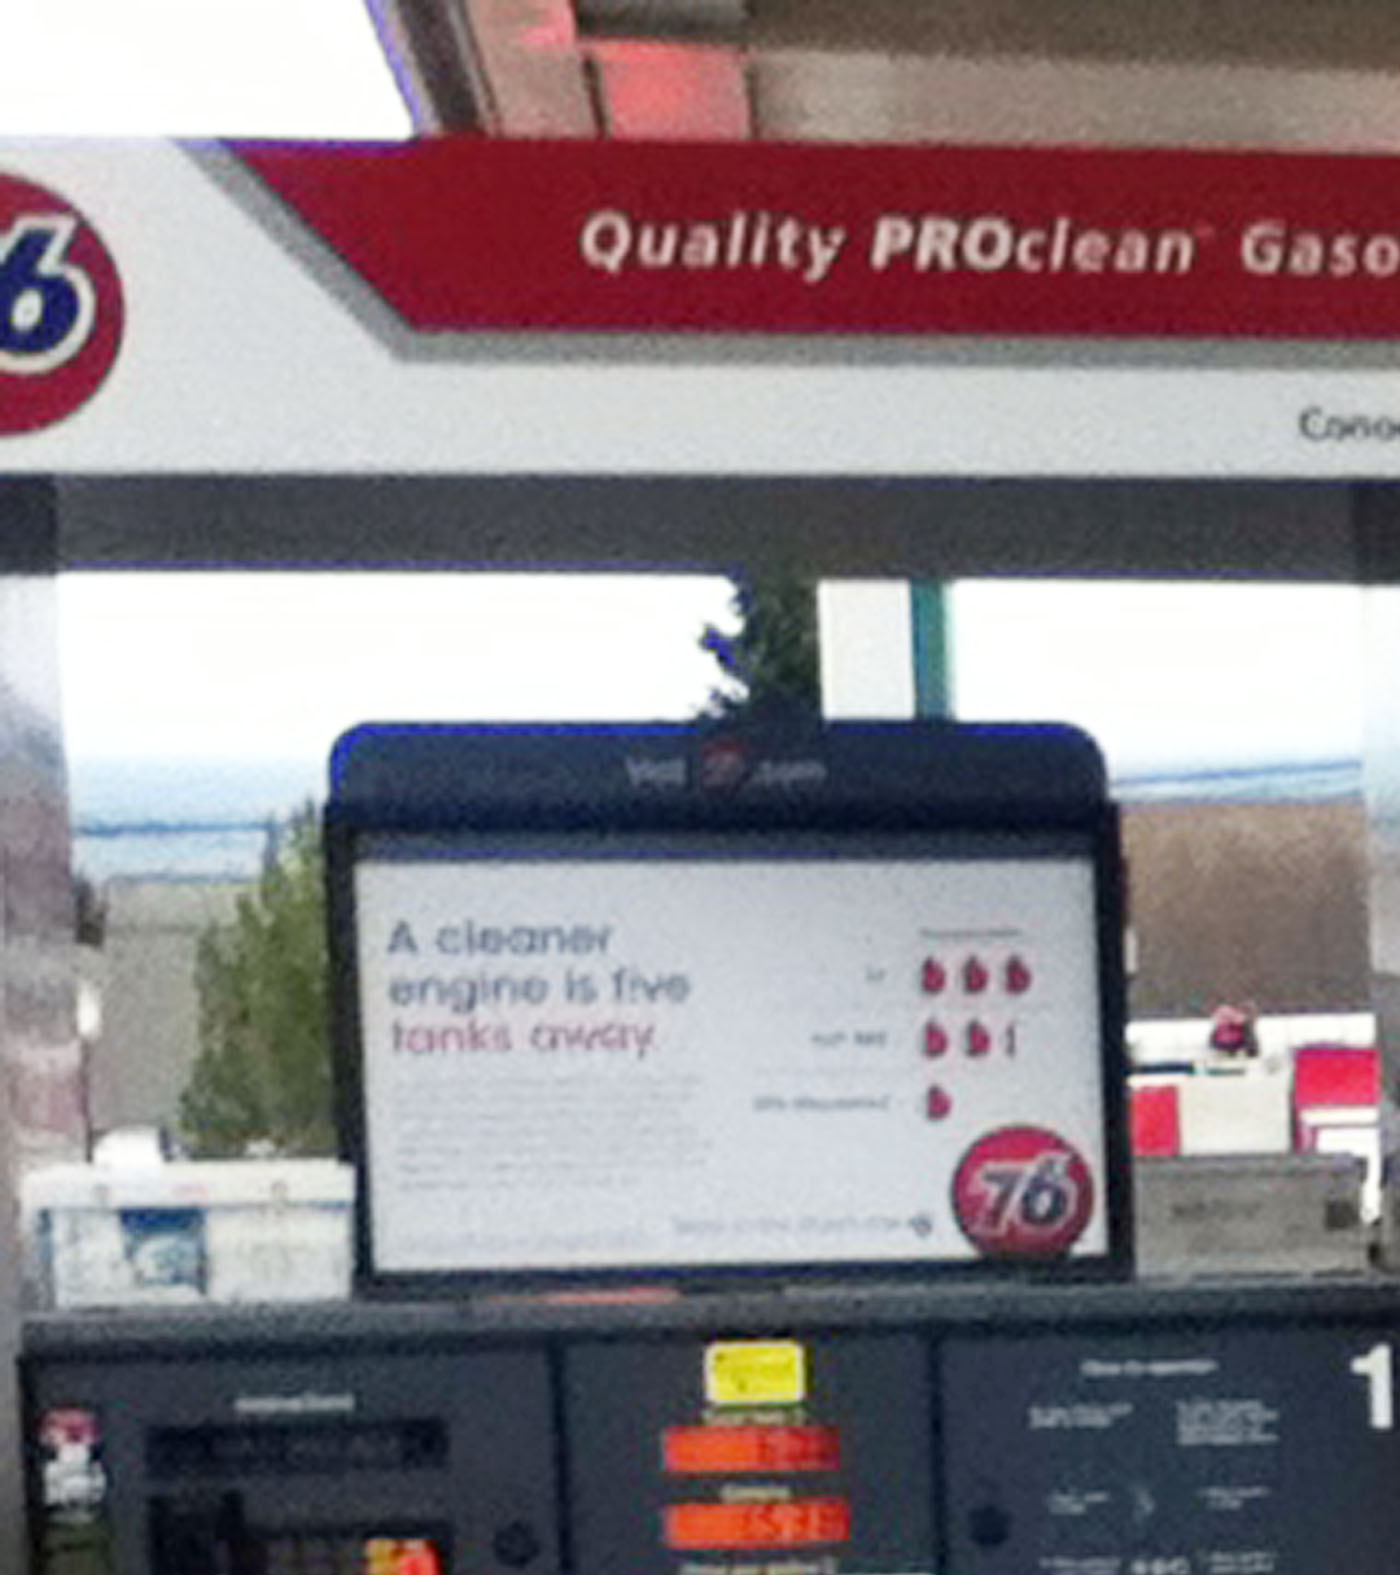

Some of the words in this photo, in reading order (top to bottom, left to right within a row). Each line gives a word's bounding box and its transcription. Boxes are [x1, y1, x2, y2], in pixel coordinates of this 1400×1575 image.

[580, 208, 848, 283] Quality
[869, 214, 1197, 275] PROclean
[0, 213, 95, 374] 6
[387, 917, 419, 952] A
[434, 918, 614, 956] cleaner
[388, 972, 551, 1014] engine
[566, 970, 600, 1005] is
[611, 966, 692, 1006] five
[391, 1019, 513, 1053] tanks
[968, 1151, 1078, 1239] 76
[1350, 1342, 1394, 1430] 1
